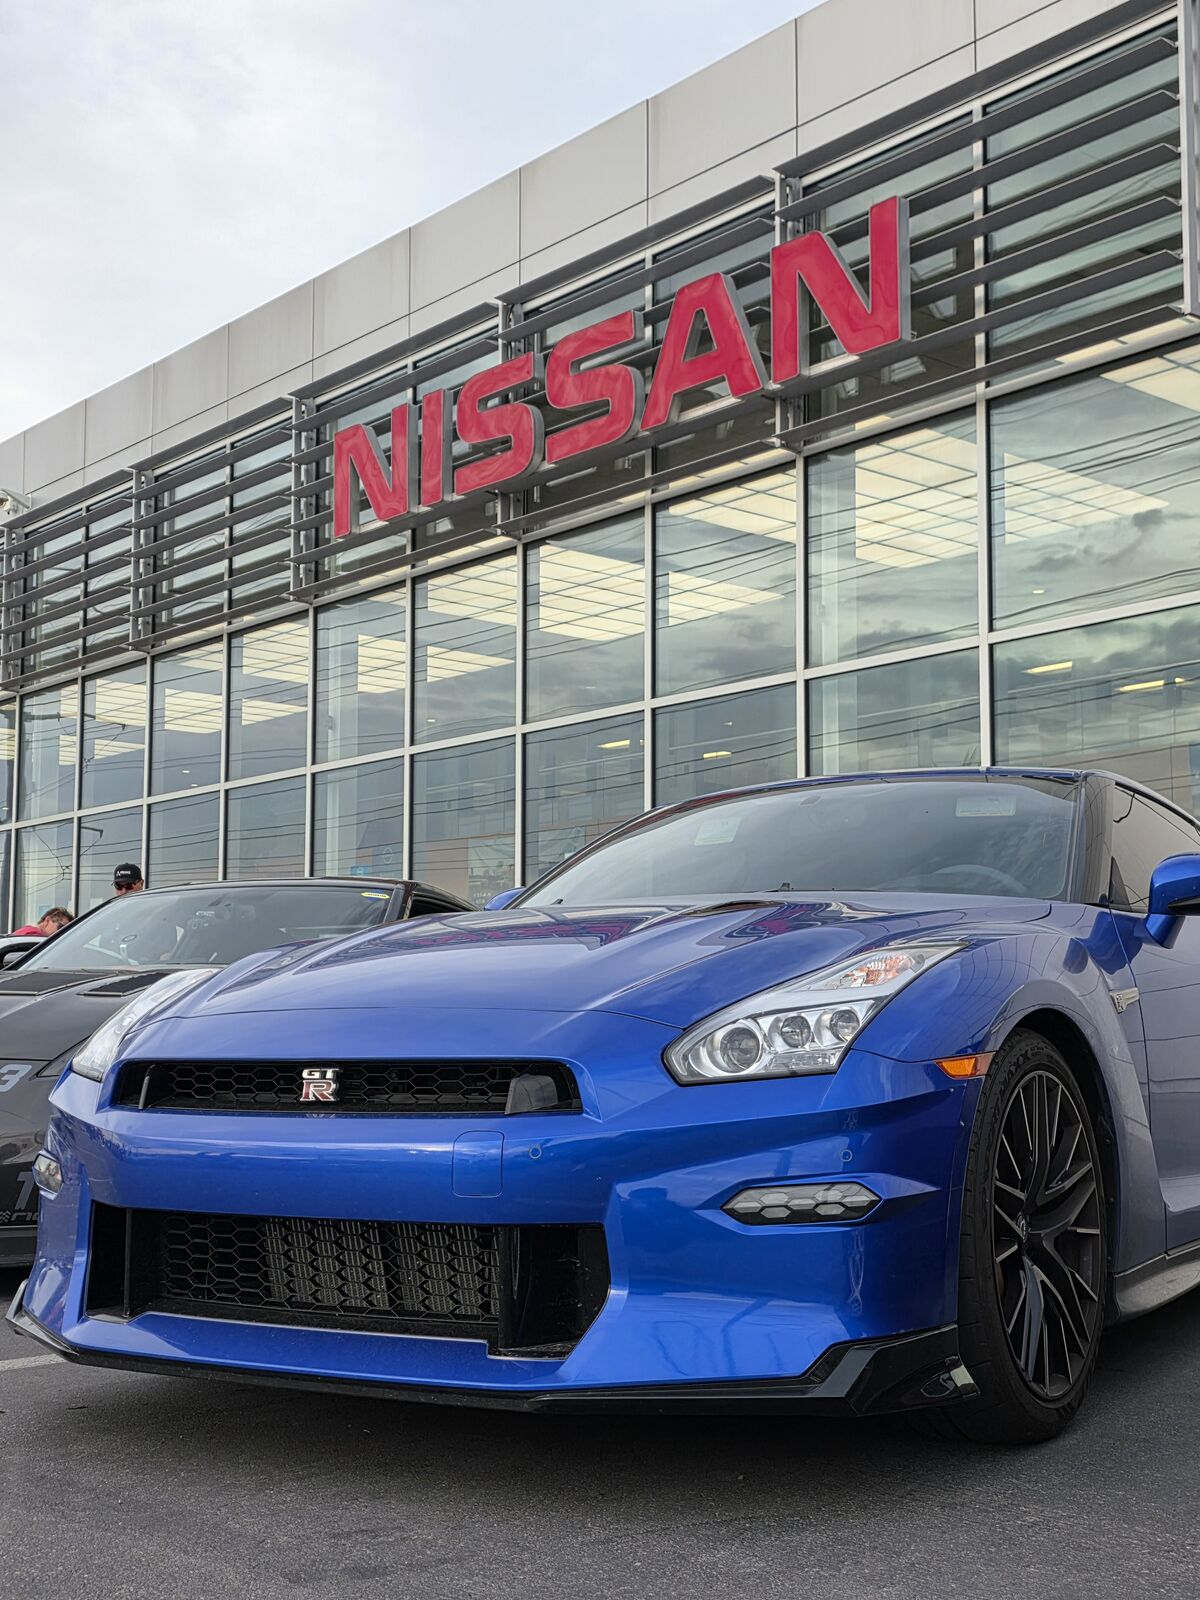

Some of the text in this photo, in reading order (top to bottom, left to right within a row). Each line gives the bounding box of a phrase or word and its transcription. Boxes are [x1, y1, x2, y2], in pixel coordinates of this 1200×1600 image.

[333, 195, 905, 538] NISSAN
[302, 1068, 339, 1079] GT
[300, 1080, 336, 1101] R
